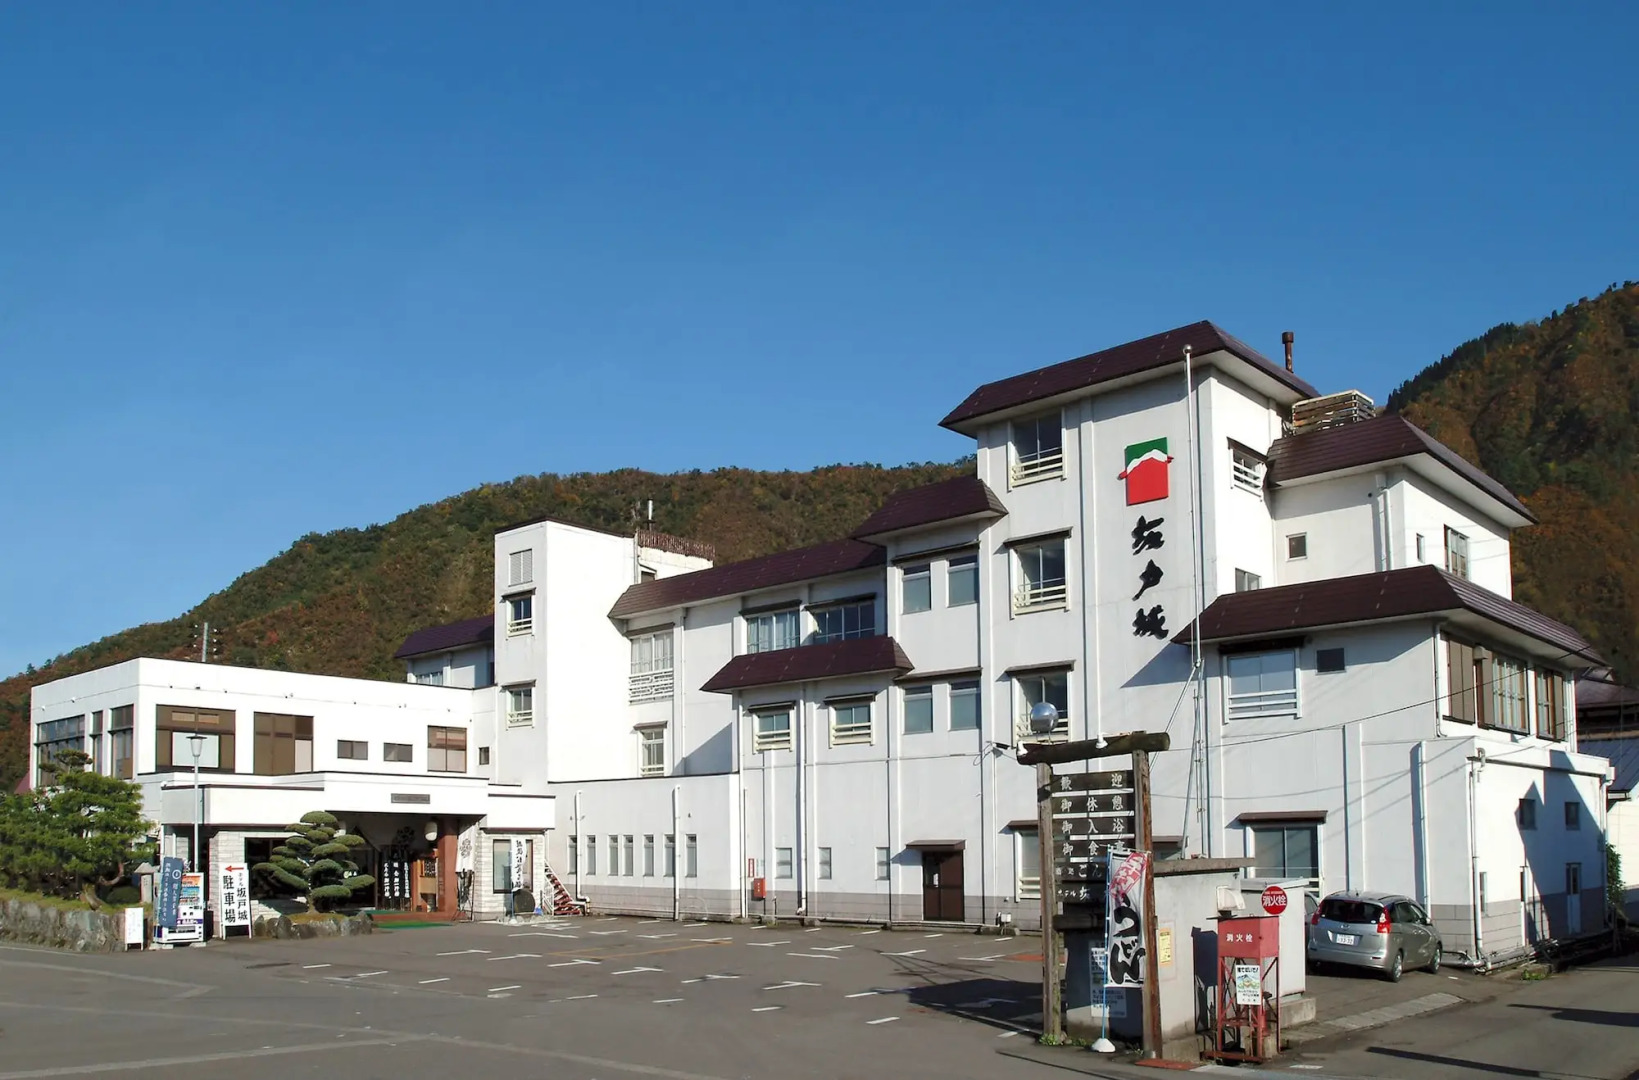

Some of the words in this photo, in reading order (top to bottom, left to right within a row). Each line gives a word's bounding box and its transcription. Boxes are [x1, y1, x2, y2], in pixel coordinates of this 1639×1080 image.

[1060, 795, 1124, 812] 御休憩
[1061, 818, 1125, 835] 御入浴
[223, 875, 236, 923] 駐車場
[1262, 895, 1287, 906] 消火栓
[1110, 893, 1146, 984] うどん
[1226, 933, 1253, 943] 消火栓
